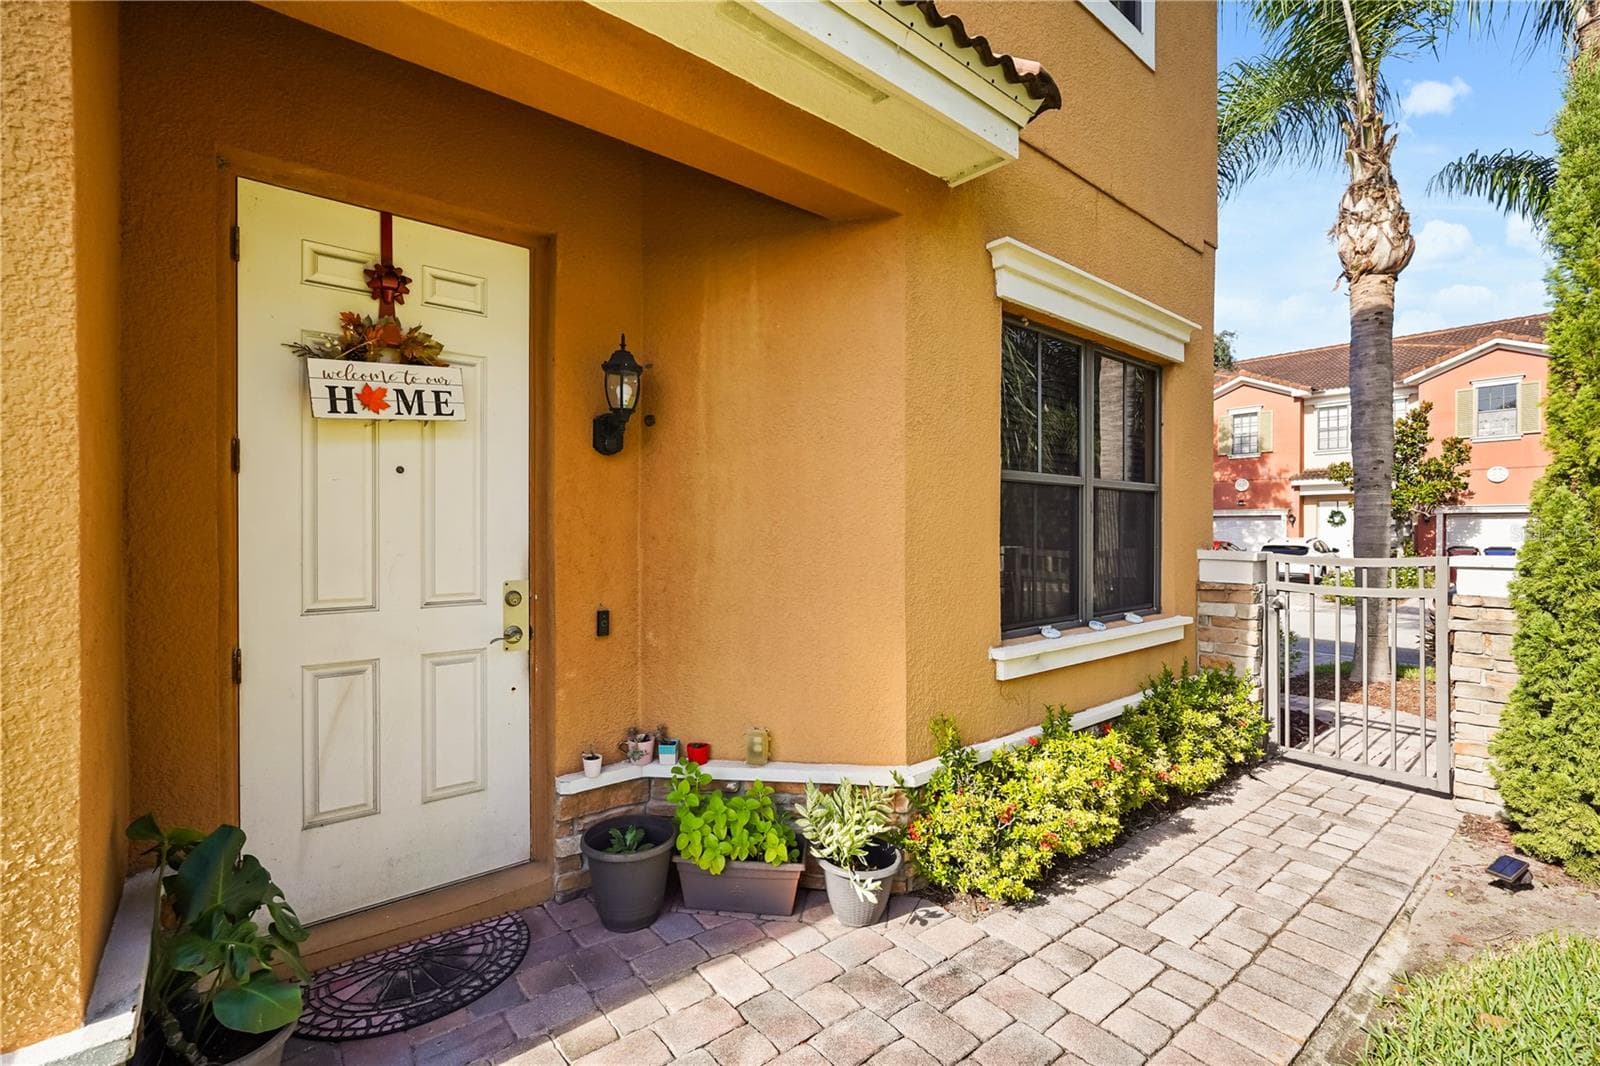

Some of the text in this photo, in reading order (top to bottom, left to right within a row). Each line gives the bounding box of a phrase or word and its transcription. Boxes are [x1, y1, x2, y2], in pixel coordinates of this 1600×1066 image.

[322, 363, 451, 386] welcome to our
[325, 384, 455, 417] HME
